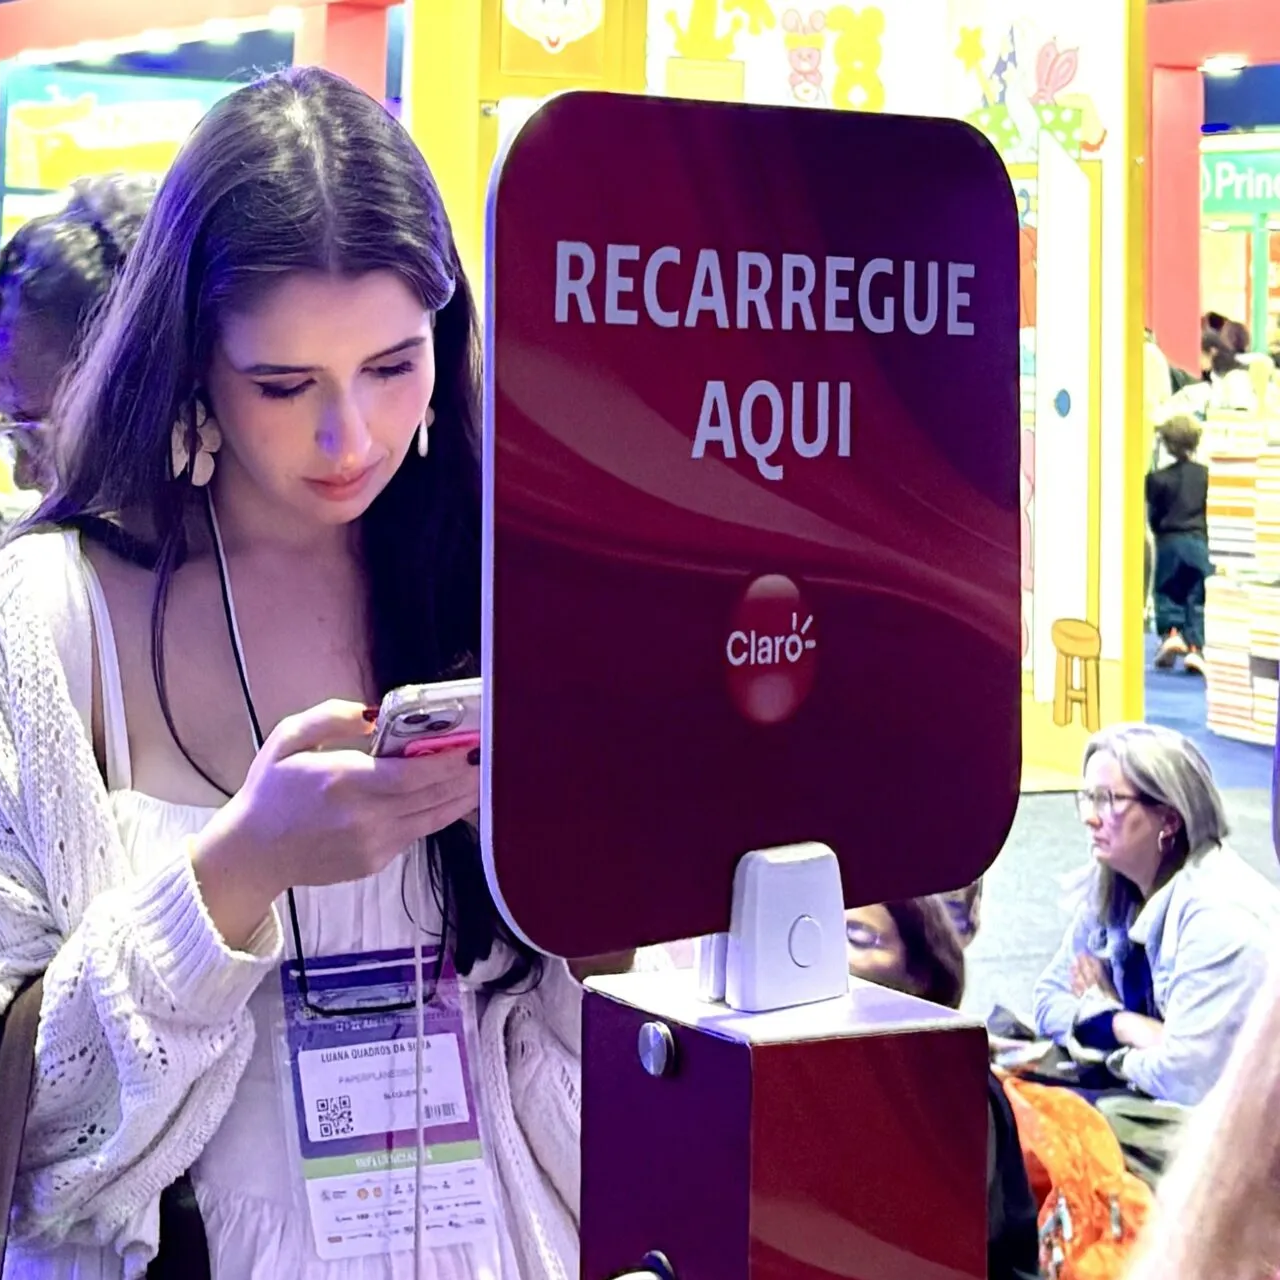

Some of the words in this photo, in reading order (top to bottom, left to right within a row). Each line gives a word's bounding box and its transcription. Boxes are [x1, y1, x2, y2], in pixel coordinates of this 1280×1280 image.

[554, 240, 976, 336] RECARREGUE
[690, 379, 851, 480] AQUI
[726, 628, 804, 667] Claro
